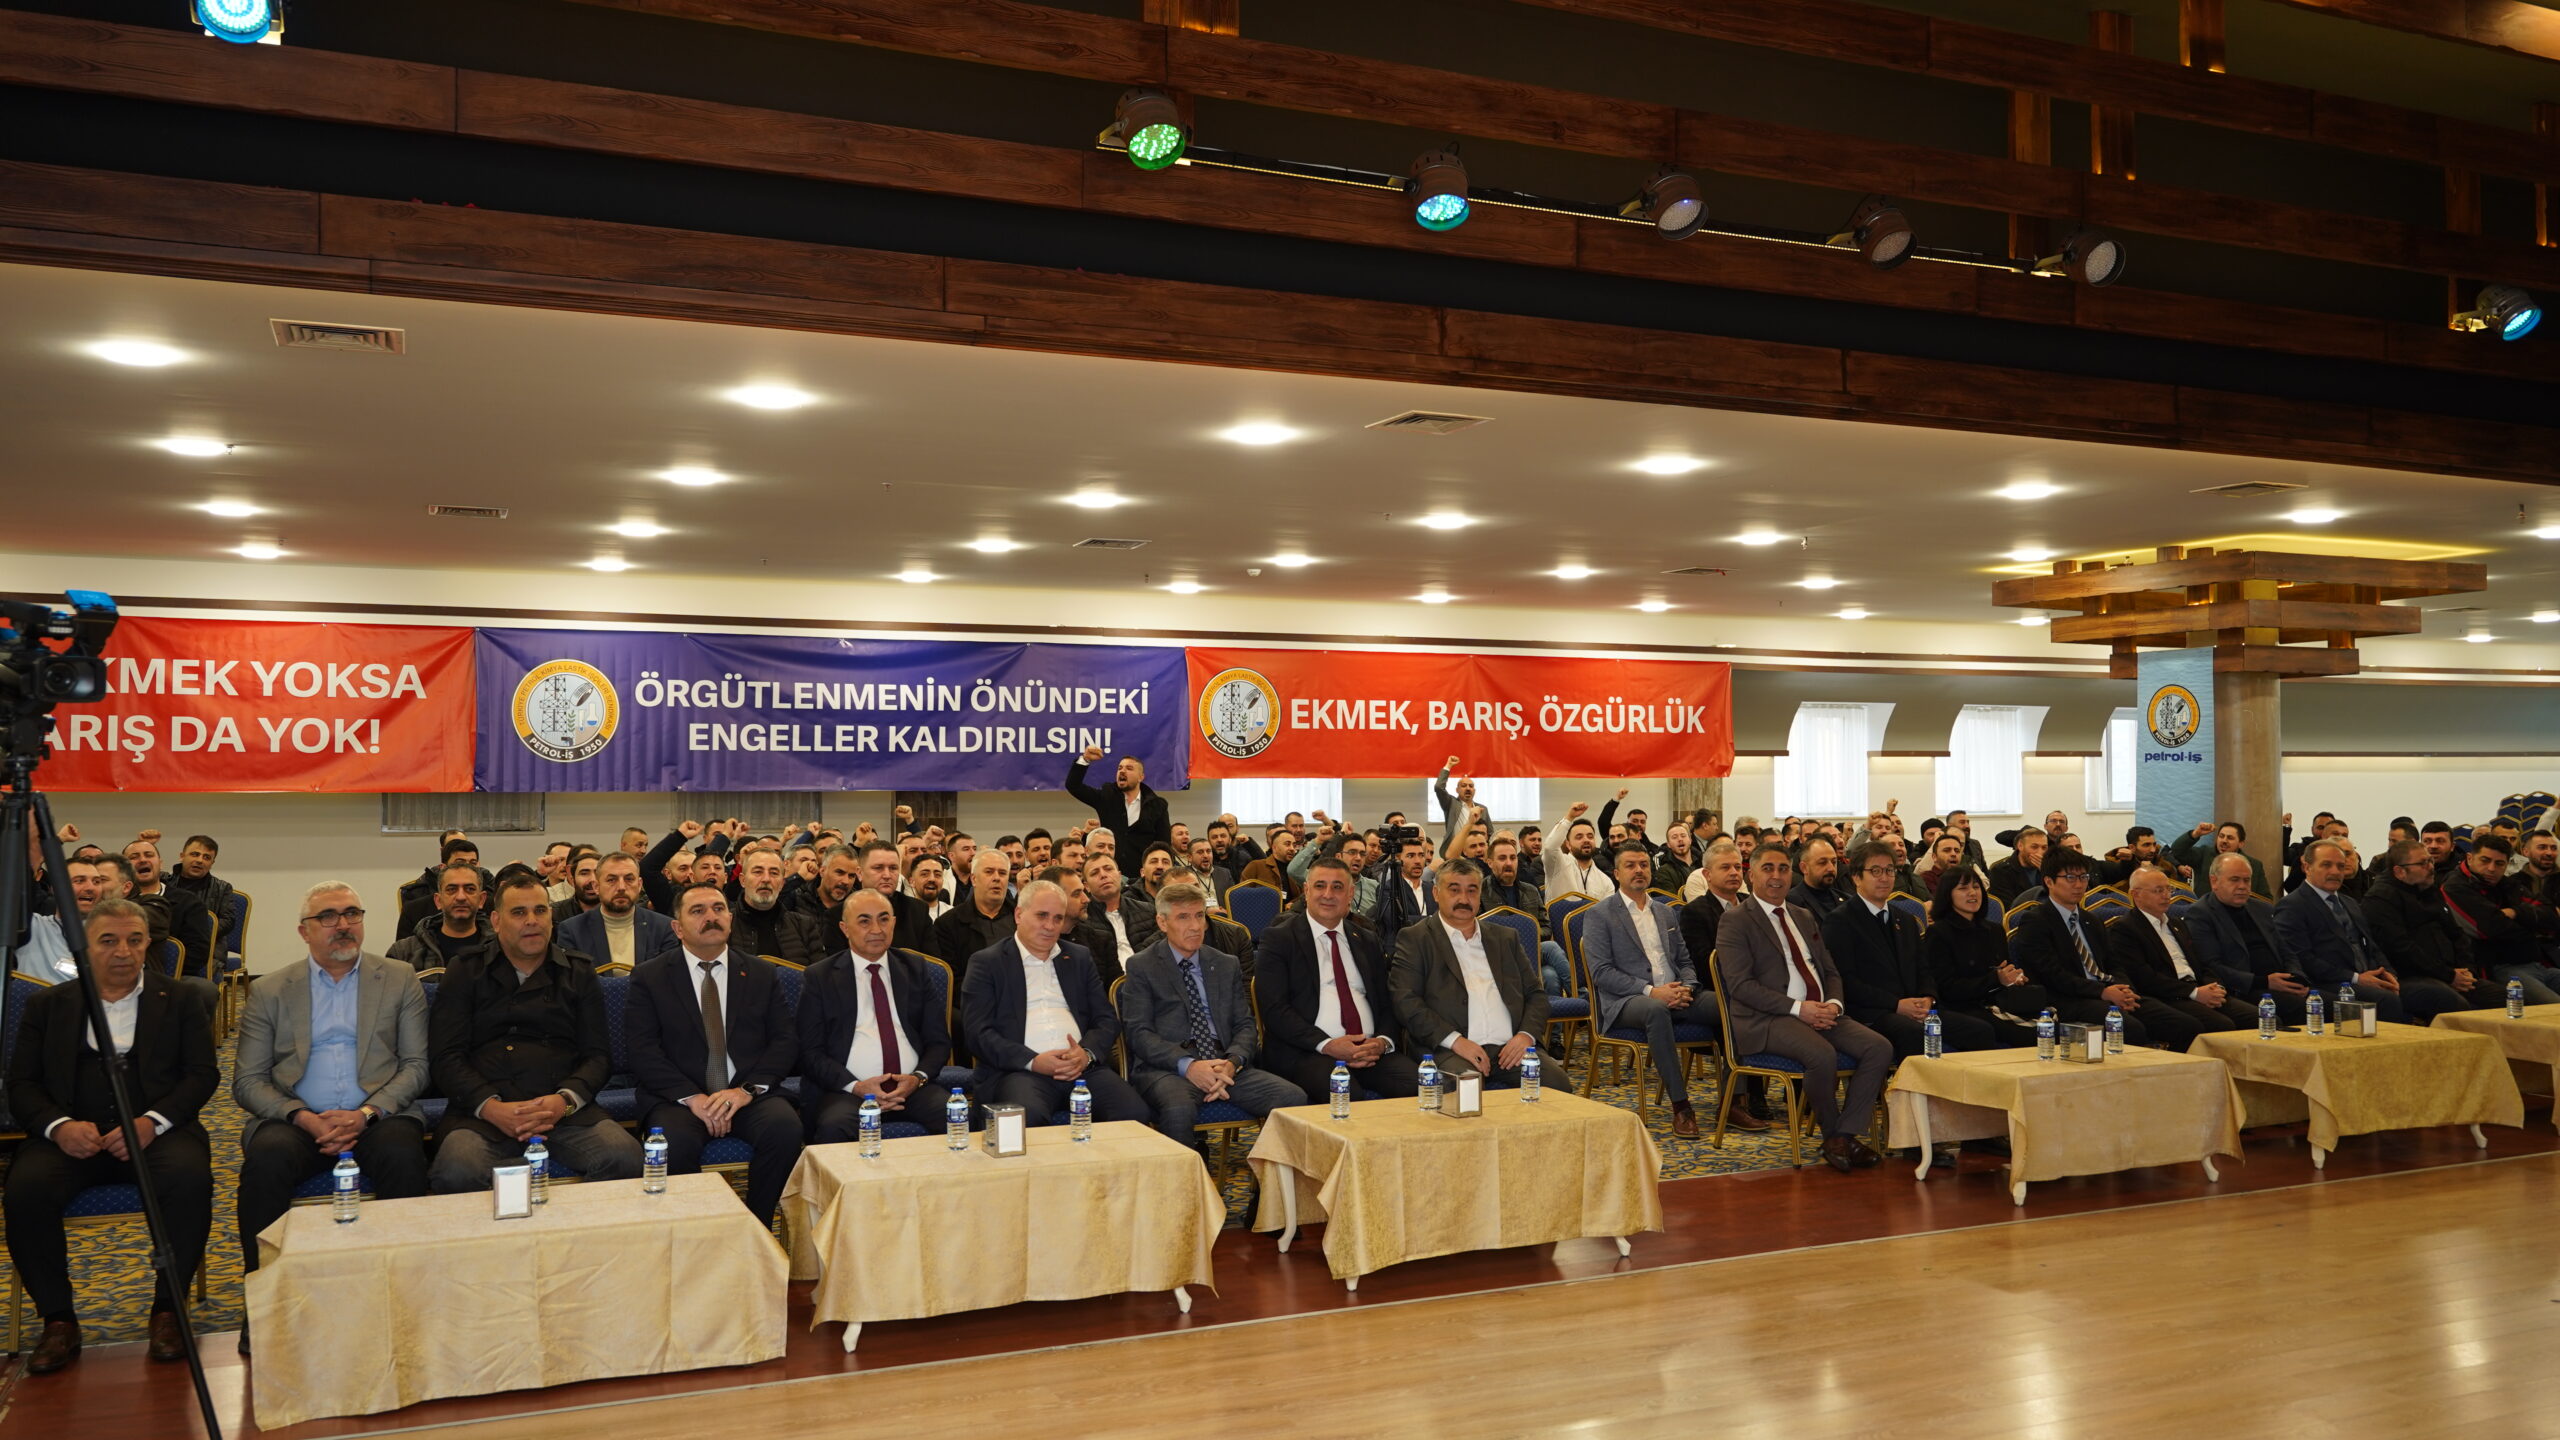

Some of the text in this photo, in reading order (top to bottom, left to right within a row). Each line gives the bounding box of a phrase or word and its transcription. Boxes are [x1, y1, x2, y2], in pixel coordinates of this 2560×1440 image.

[105, 657, 427, 699] MEK YOKSA
[634, 670, 1149, 715] ÖRGÜTLENMENİN ÖNÜNDEKİ
[1291, 698, 1419, 735] EKMEK,
[1428, 700, 1531, 741] BARIŞ,
[1539, 695, 1706, 734] ÖZGÜRLÜK
[43, 714, 380, 763] ARIŞ DA YOK!
[529, 737, 603, 760] PETROL-İŞ 1950
[689, 723, 1112, 754] ENGELLER KALDIRILSIN!
[1212, 736, 1268, 756] PETROL-İŞ 1950
[2144, 751, 2203, 764] petrol-iş
